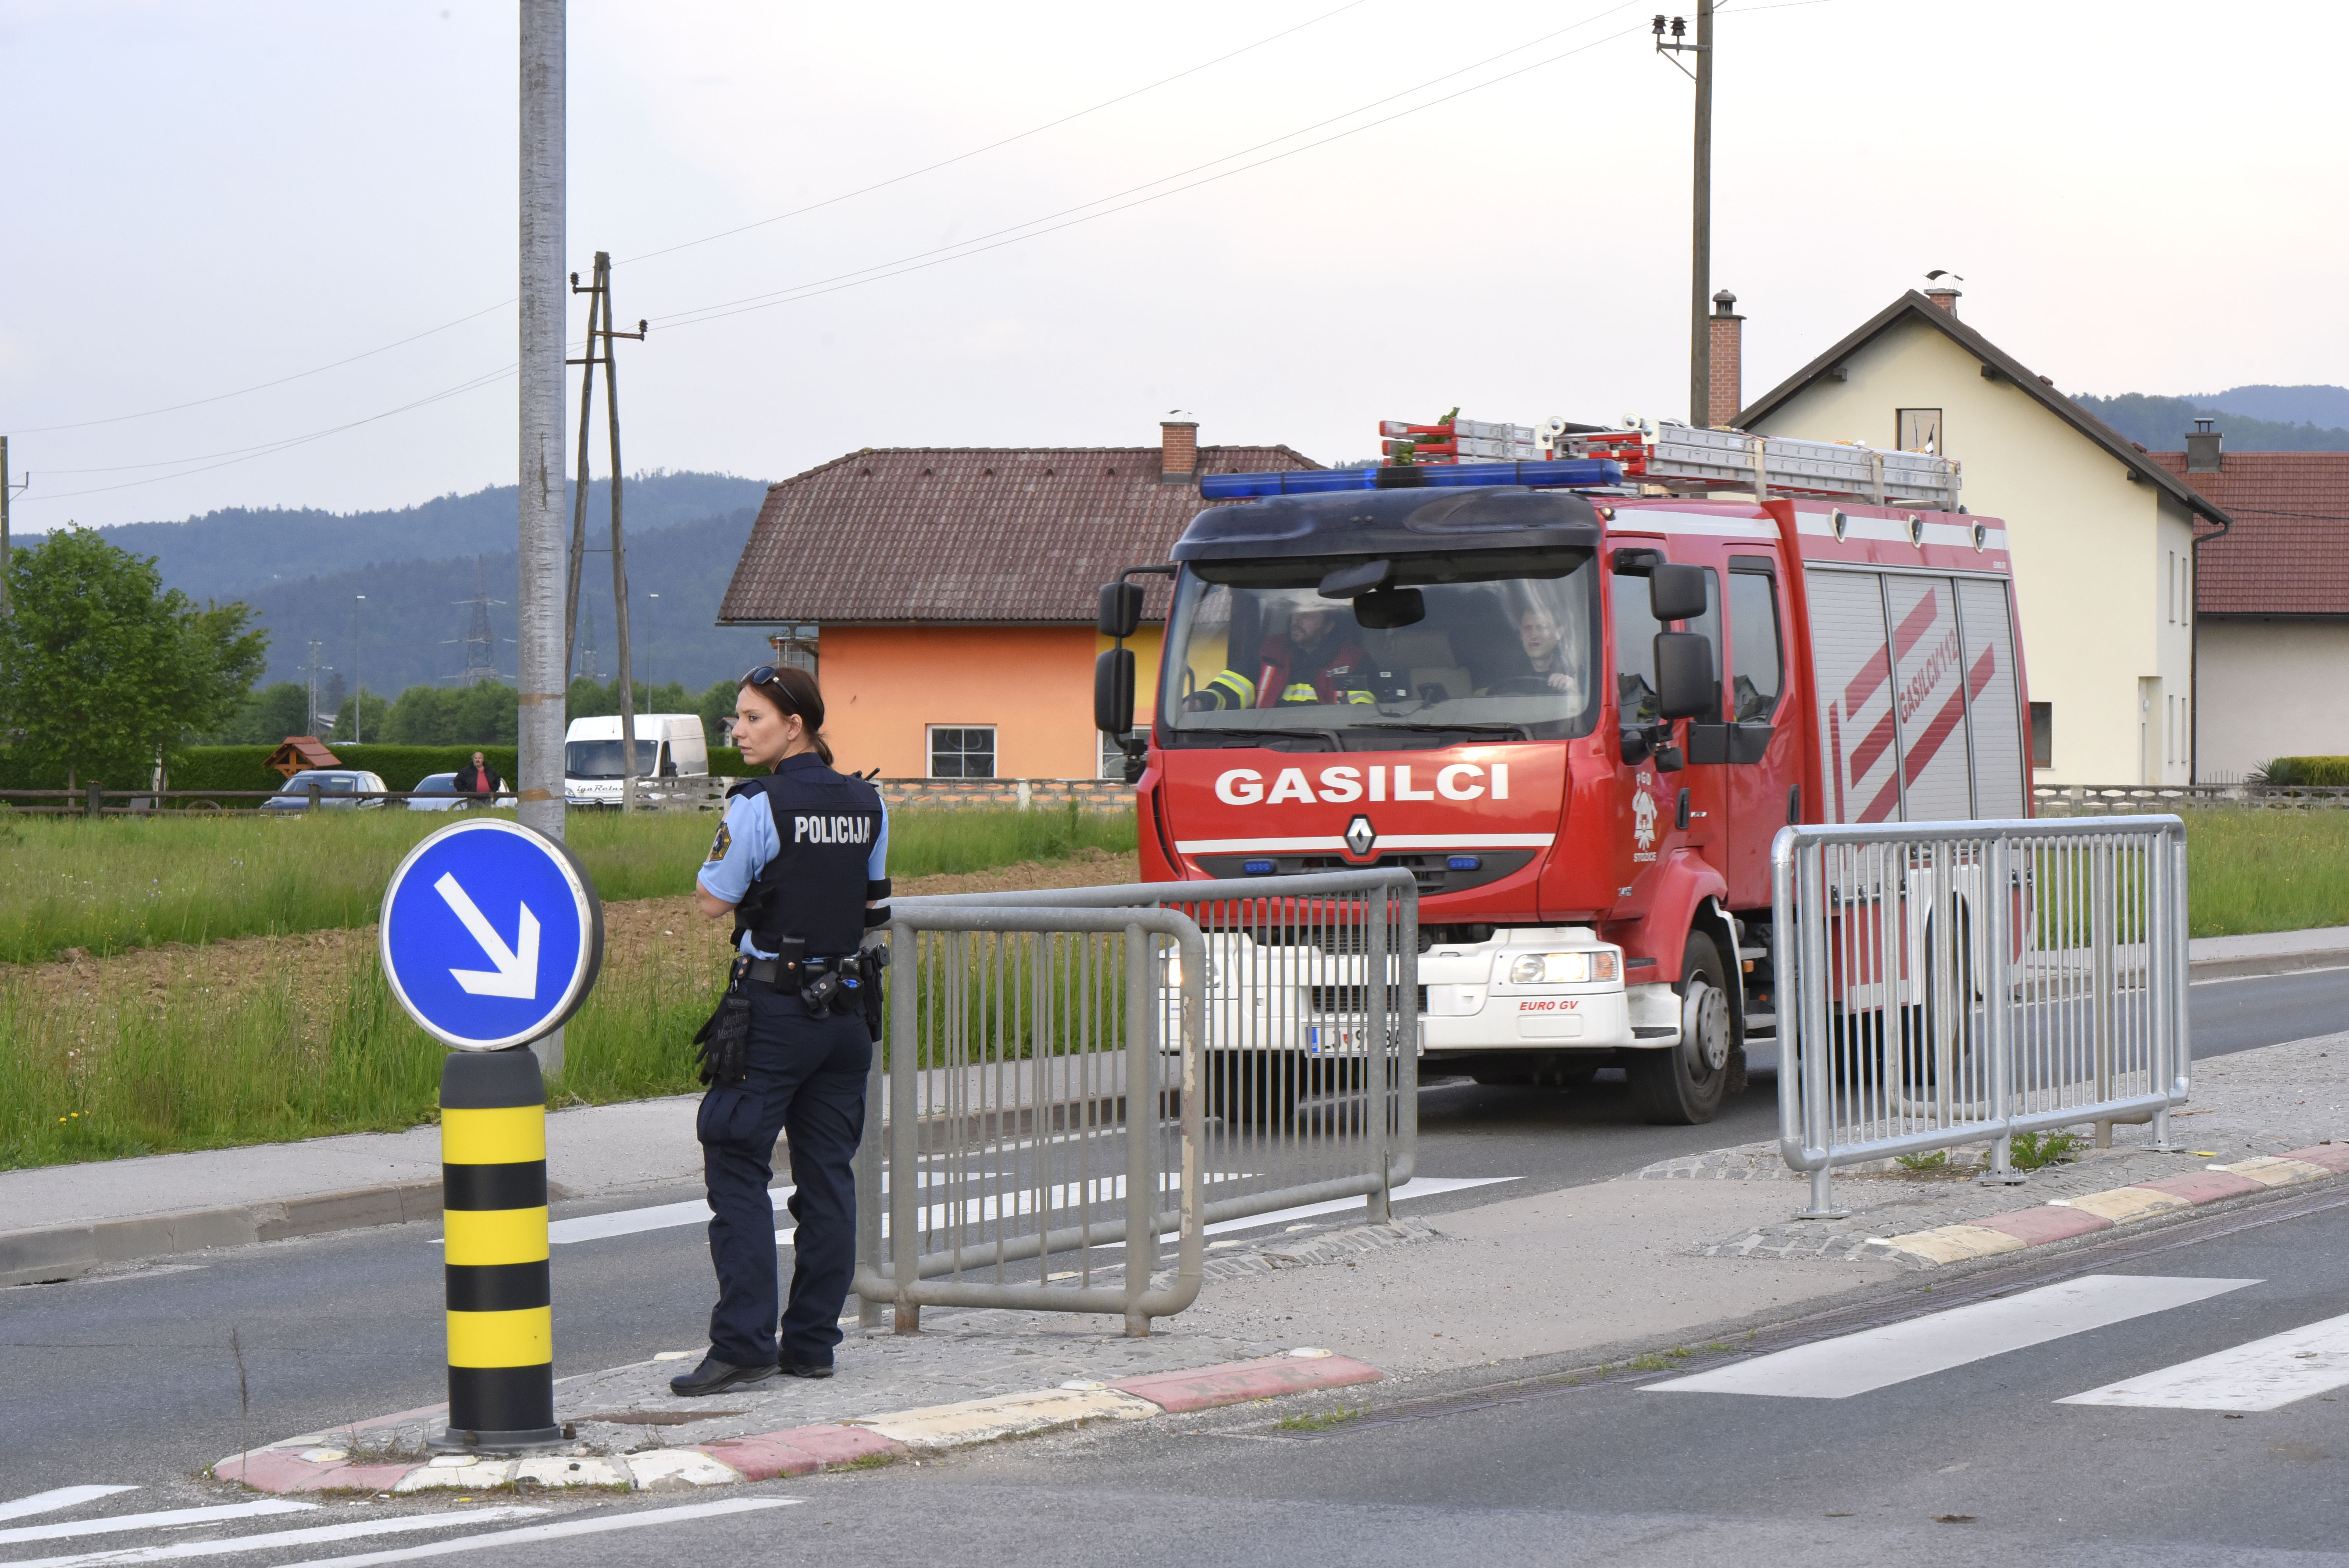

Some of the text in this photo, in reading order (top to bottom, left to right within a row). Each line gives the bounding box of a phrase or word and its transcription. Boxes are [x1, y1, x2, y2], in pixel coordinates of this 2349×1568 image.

[1215, 763, 1509, 805] GASILCI
[795, 816, 870, 844] POLICIJA
[1519, 1001, 1579, 1010] EURO GV
